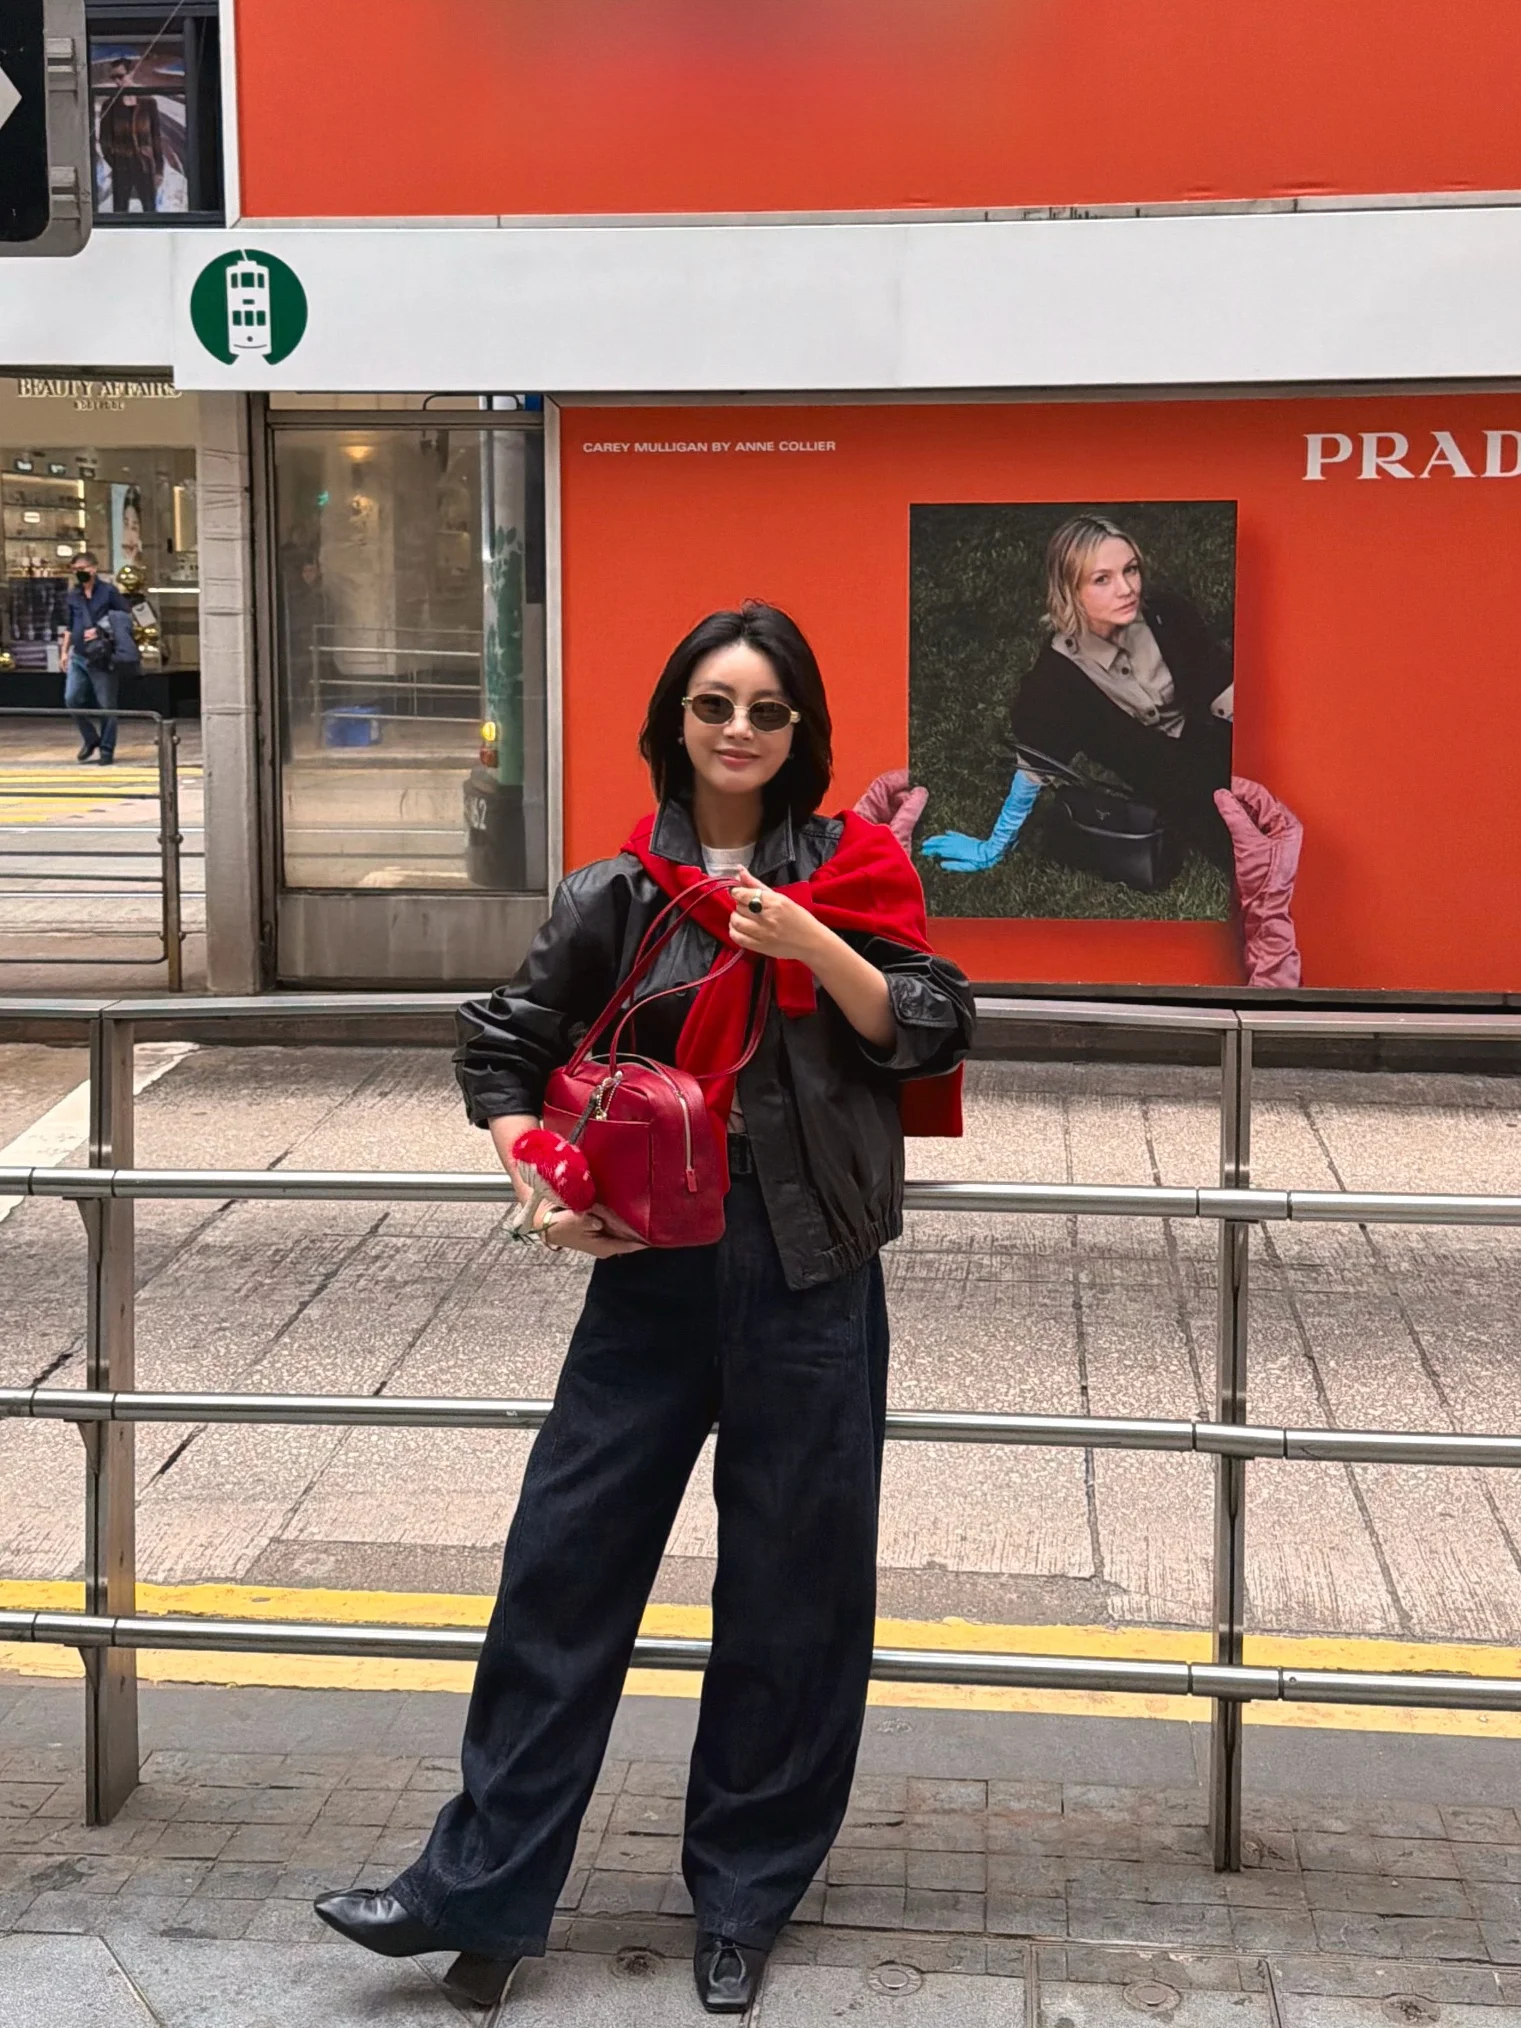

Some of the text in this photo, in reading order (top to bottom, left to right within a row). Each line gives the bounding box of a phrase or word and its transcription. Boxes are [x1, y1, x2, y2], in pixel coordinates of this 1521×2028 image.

[18, 378, 93, 398] BEAUTY
[583, 440, 836, 453] CAREY MULLIGAN BY ANNE COLLIER
[1301, 430, 1521, 480] PRAD
